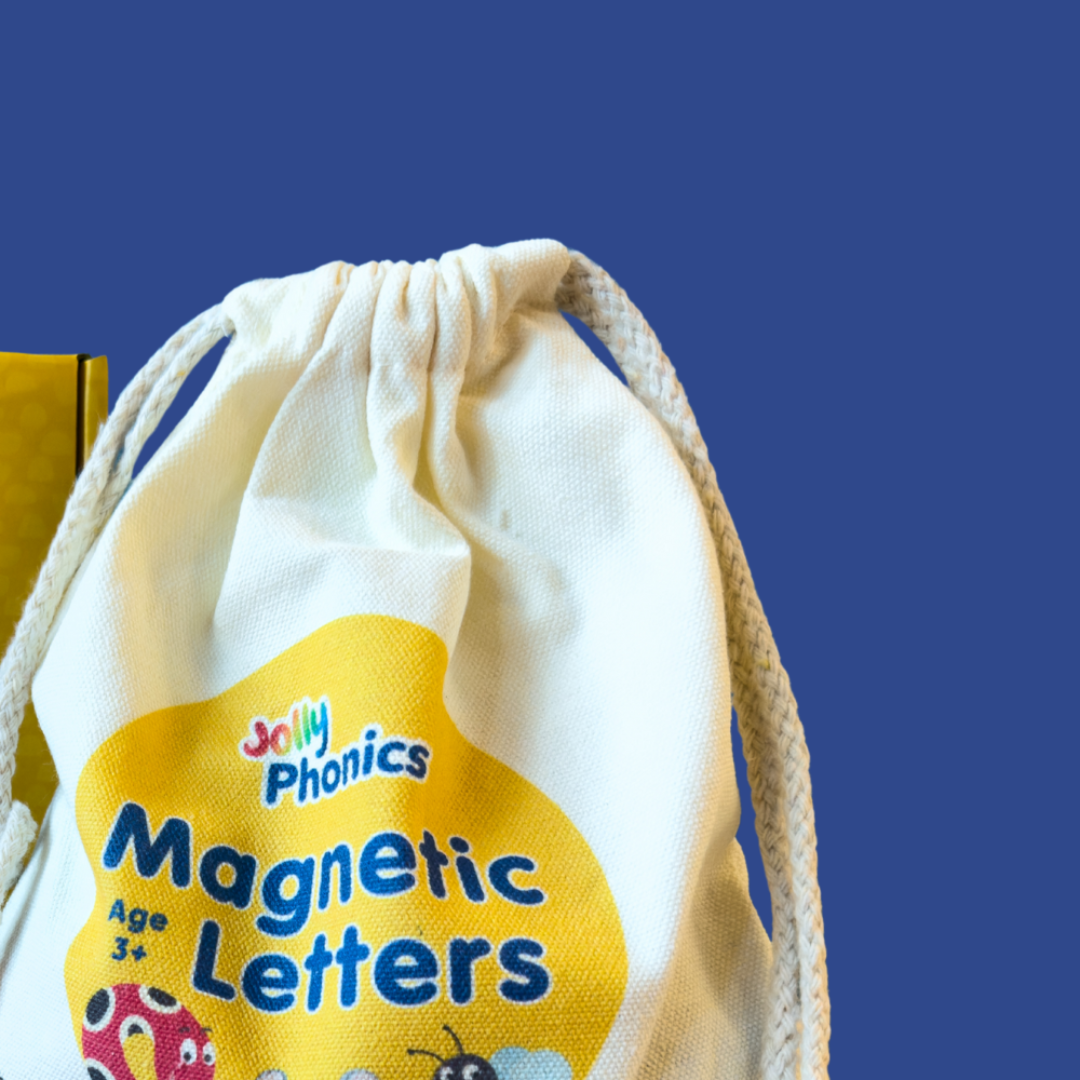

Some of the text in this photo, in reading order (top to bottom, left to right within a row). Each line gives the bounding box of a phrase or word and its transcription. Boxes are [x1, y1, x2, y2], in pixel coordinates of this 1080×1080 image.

[243, 701, 328, 758] Jolly
[266, 730, 430, 805] Phonics
[102, 802, 545, 937] Magnetic
[108, 898, 169, 933] Age
[111, 936, 147, 962] 3+
[192, 919, 551, 1012] Letters
